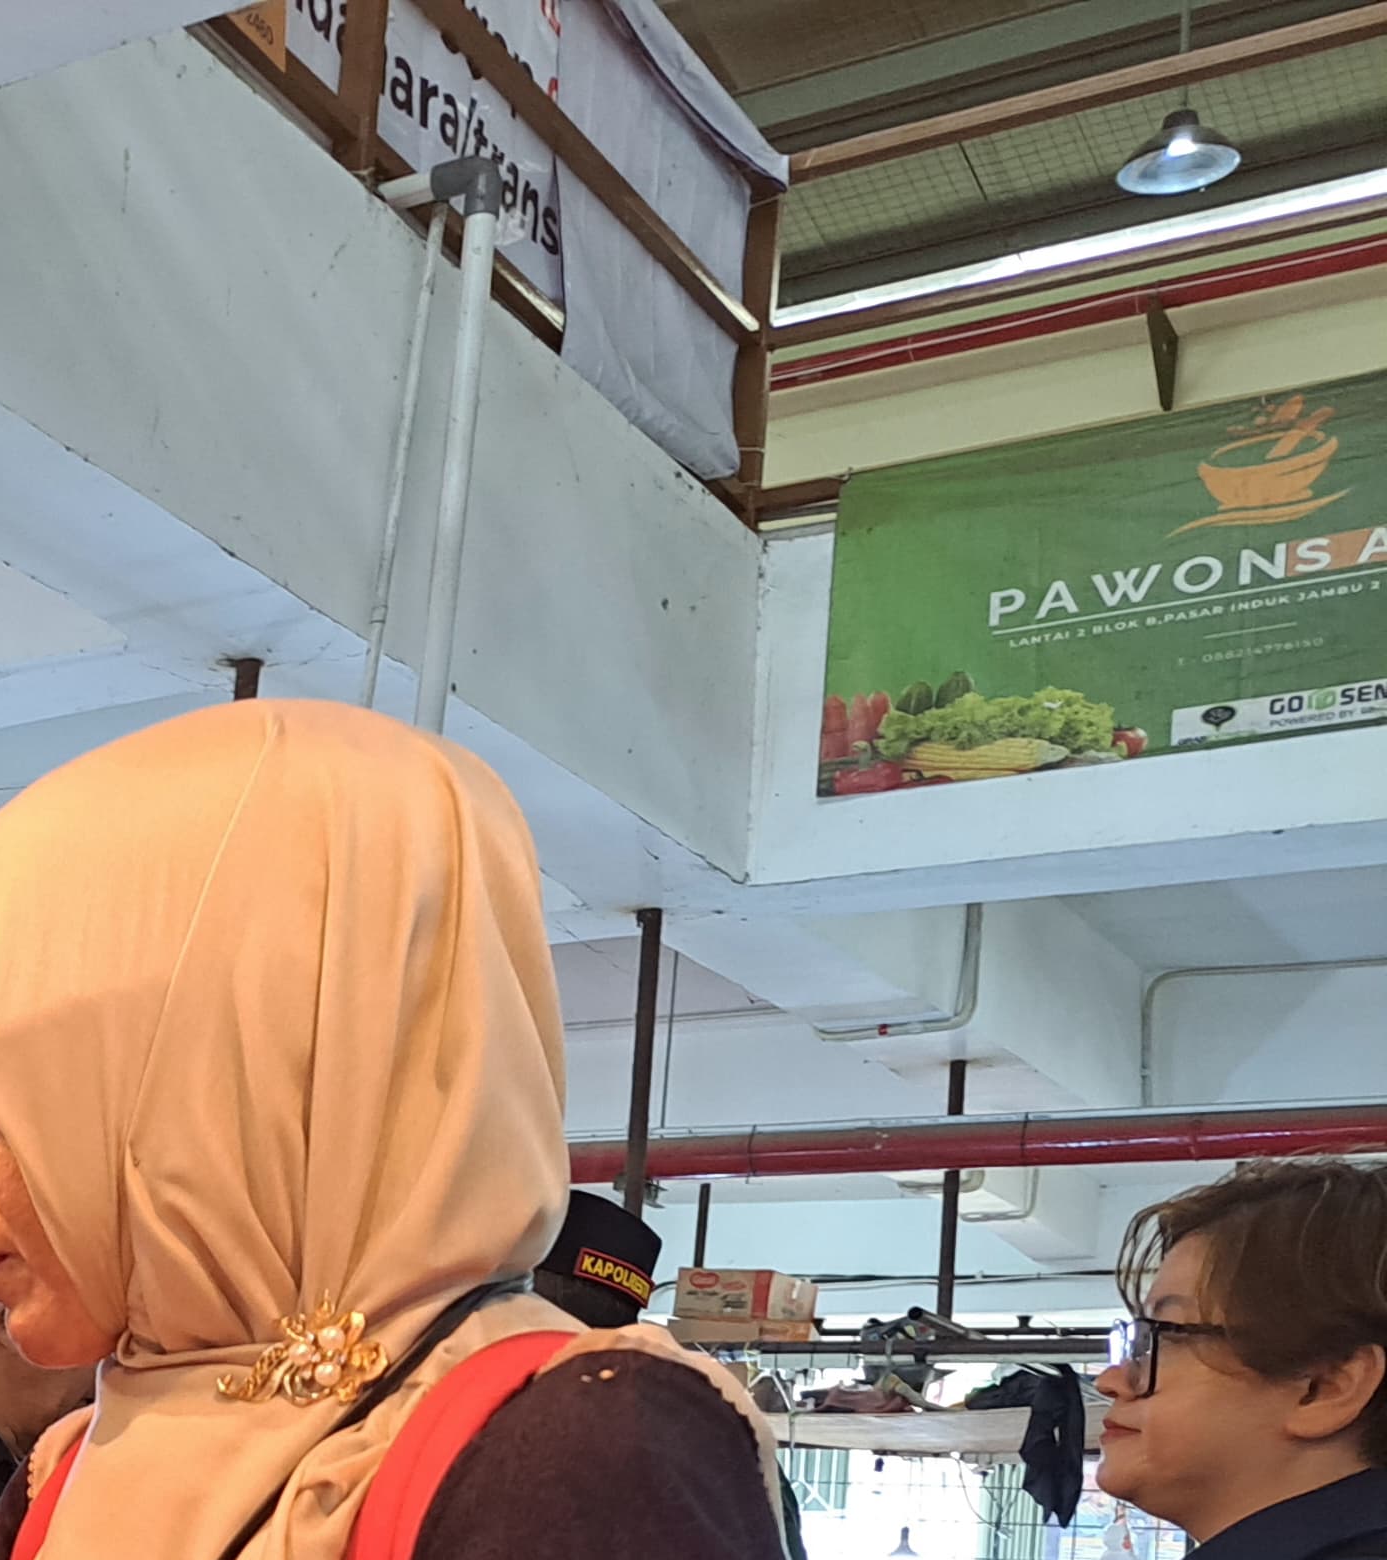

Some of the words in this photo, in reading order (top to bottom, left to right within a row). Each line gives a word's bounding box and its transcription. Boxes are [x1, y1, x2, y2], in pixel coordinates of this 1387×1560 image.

[1009, 630, 1070, 648] LANTAI
[1077, 628, 1087, 638] 2
[1092, 619, 1139, 635] BLOK
[1230, 594, 1291, 612] INDUK
[1298, 582, 1364, 602] JAMBU
[1370, 580, 1381, 590] 2
[1269, 695, 1304, 715] GO
[1269, 711, 1336, 728] POWERED
[1339, 709, 1355, 719] BY
